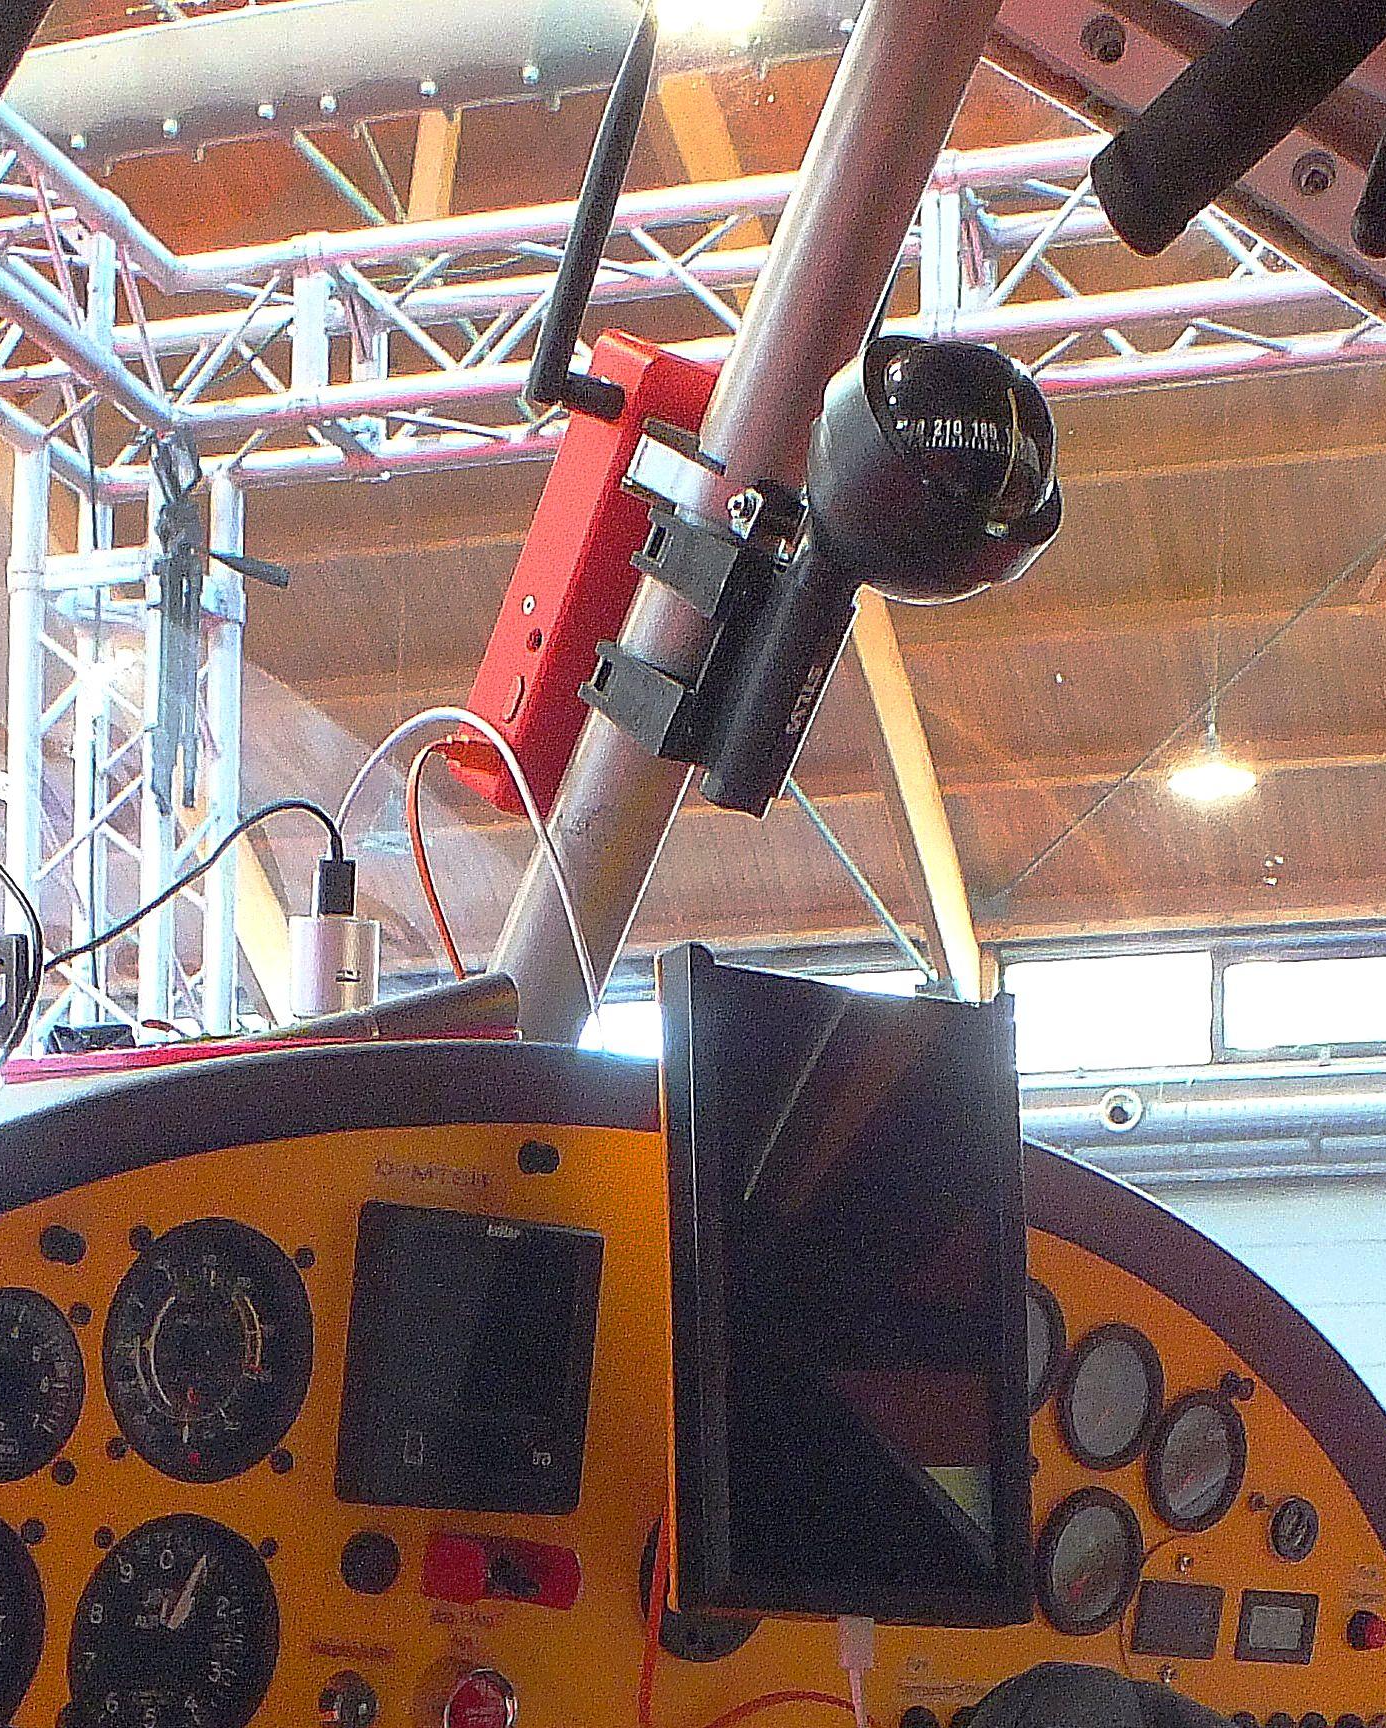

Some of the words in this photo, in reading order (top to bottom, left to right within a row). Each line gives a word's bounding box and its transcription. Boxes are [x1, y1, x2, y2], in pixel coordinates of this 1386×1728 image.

[159, 1548, 175, 1570] 0
[119, 1562, 133, 1584] 9
[89, 1603, 104, 1625] 8
[216, 1596, 230, 1618] 2
[208, 1660, 222, 1683] 3
[105, 1691, 119, 1714] 6
